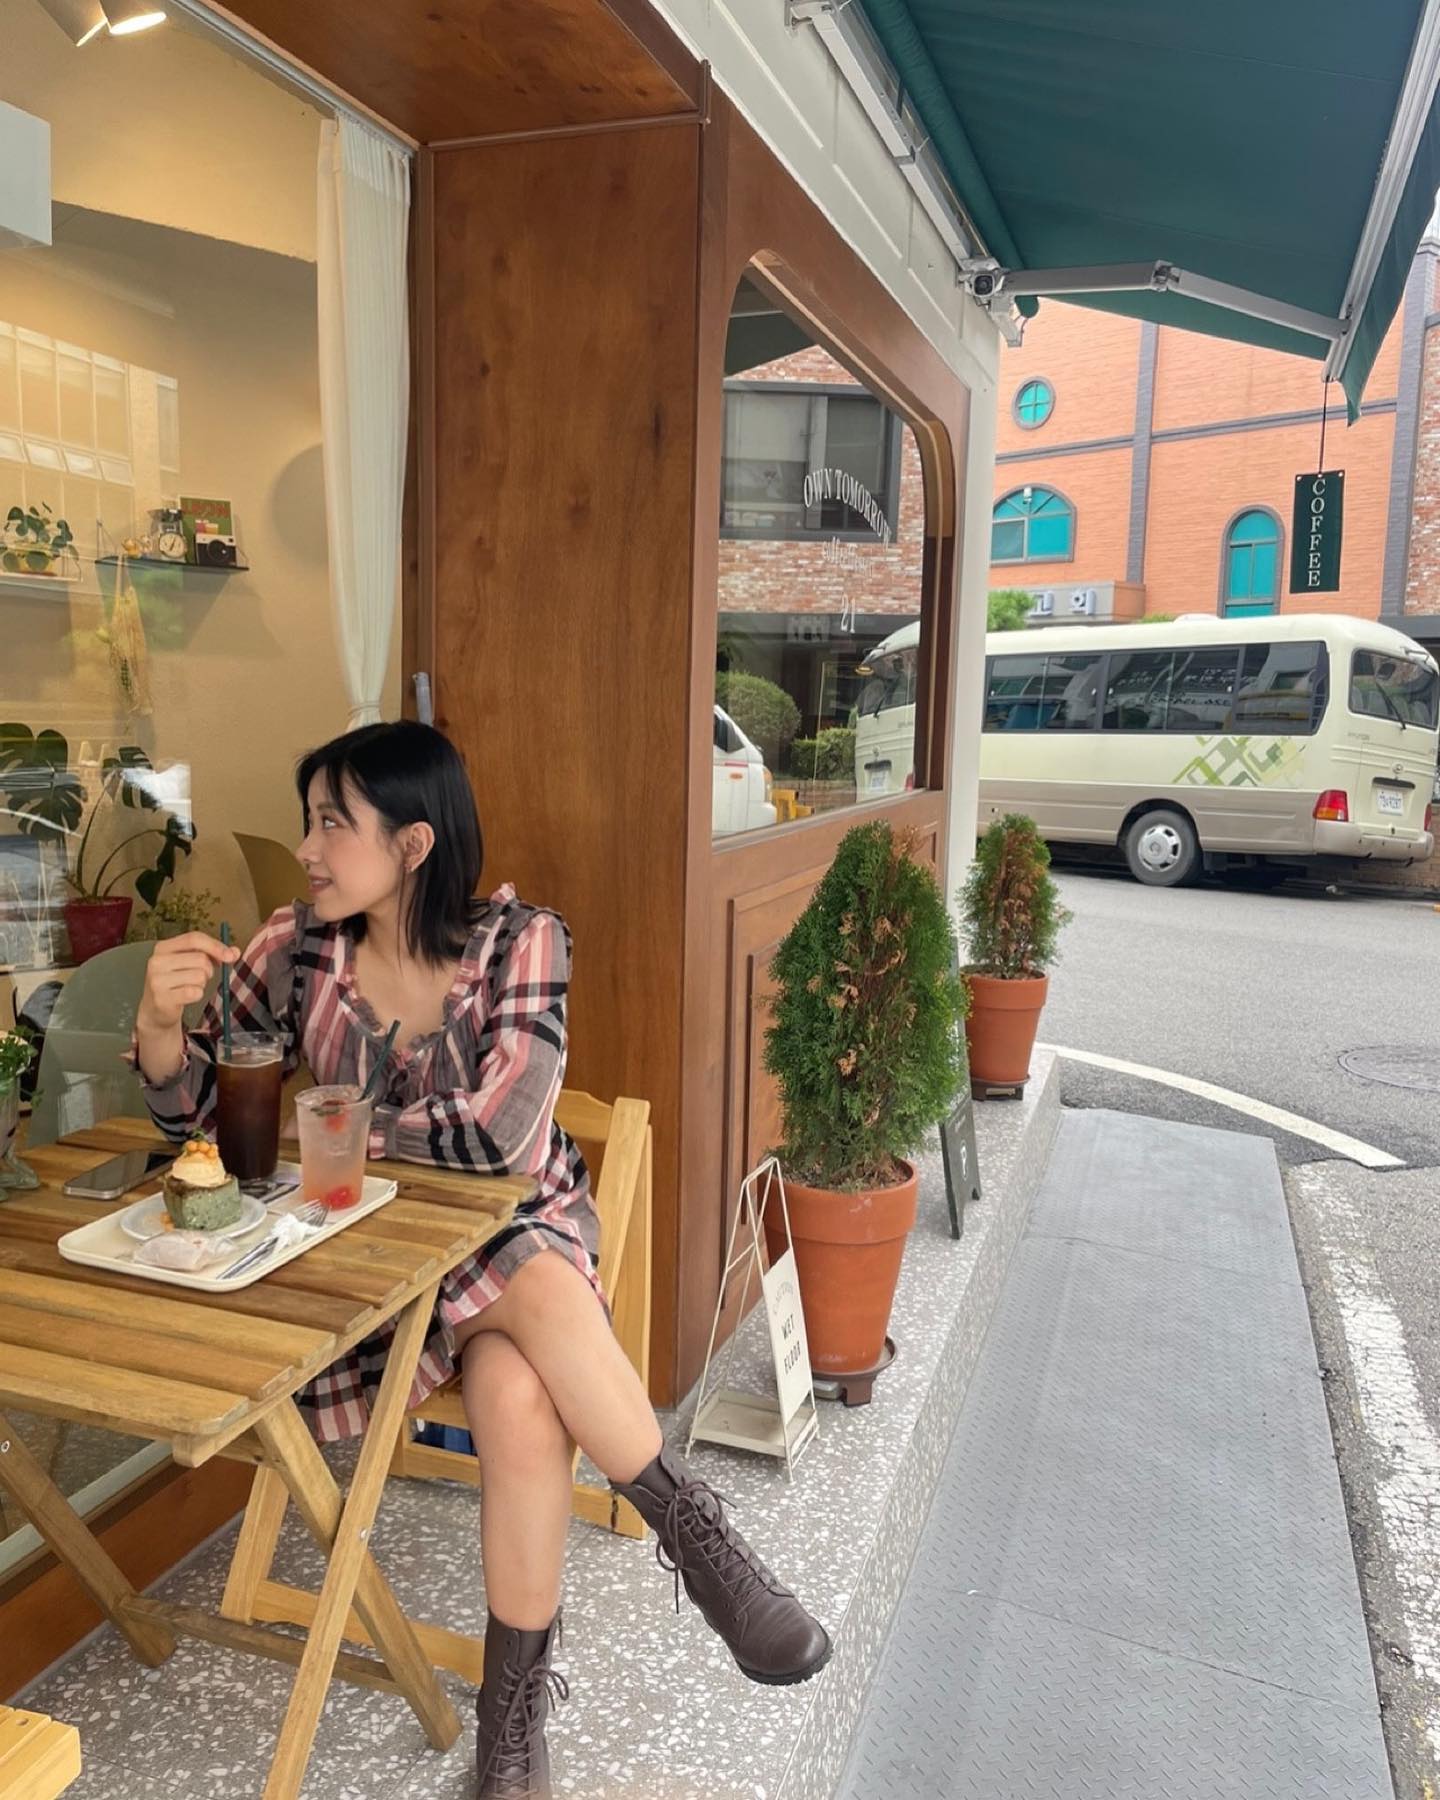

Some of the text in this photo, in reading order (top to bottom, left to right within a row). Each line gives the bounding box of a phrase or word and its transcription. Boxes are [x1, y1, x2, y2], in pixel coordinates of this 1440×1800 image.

[803, 468, 892, 552] OWN TOMORROW
[1307, 478, 1326, 587] COFFEE
[840, 594, 856, 634] 21
[781, 1314, 795, 1340] WET
[783, 1341, 800, 1375] FLOOR
